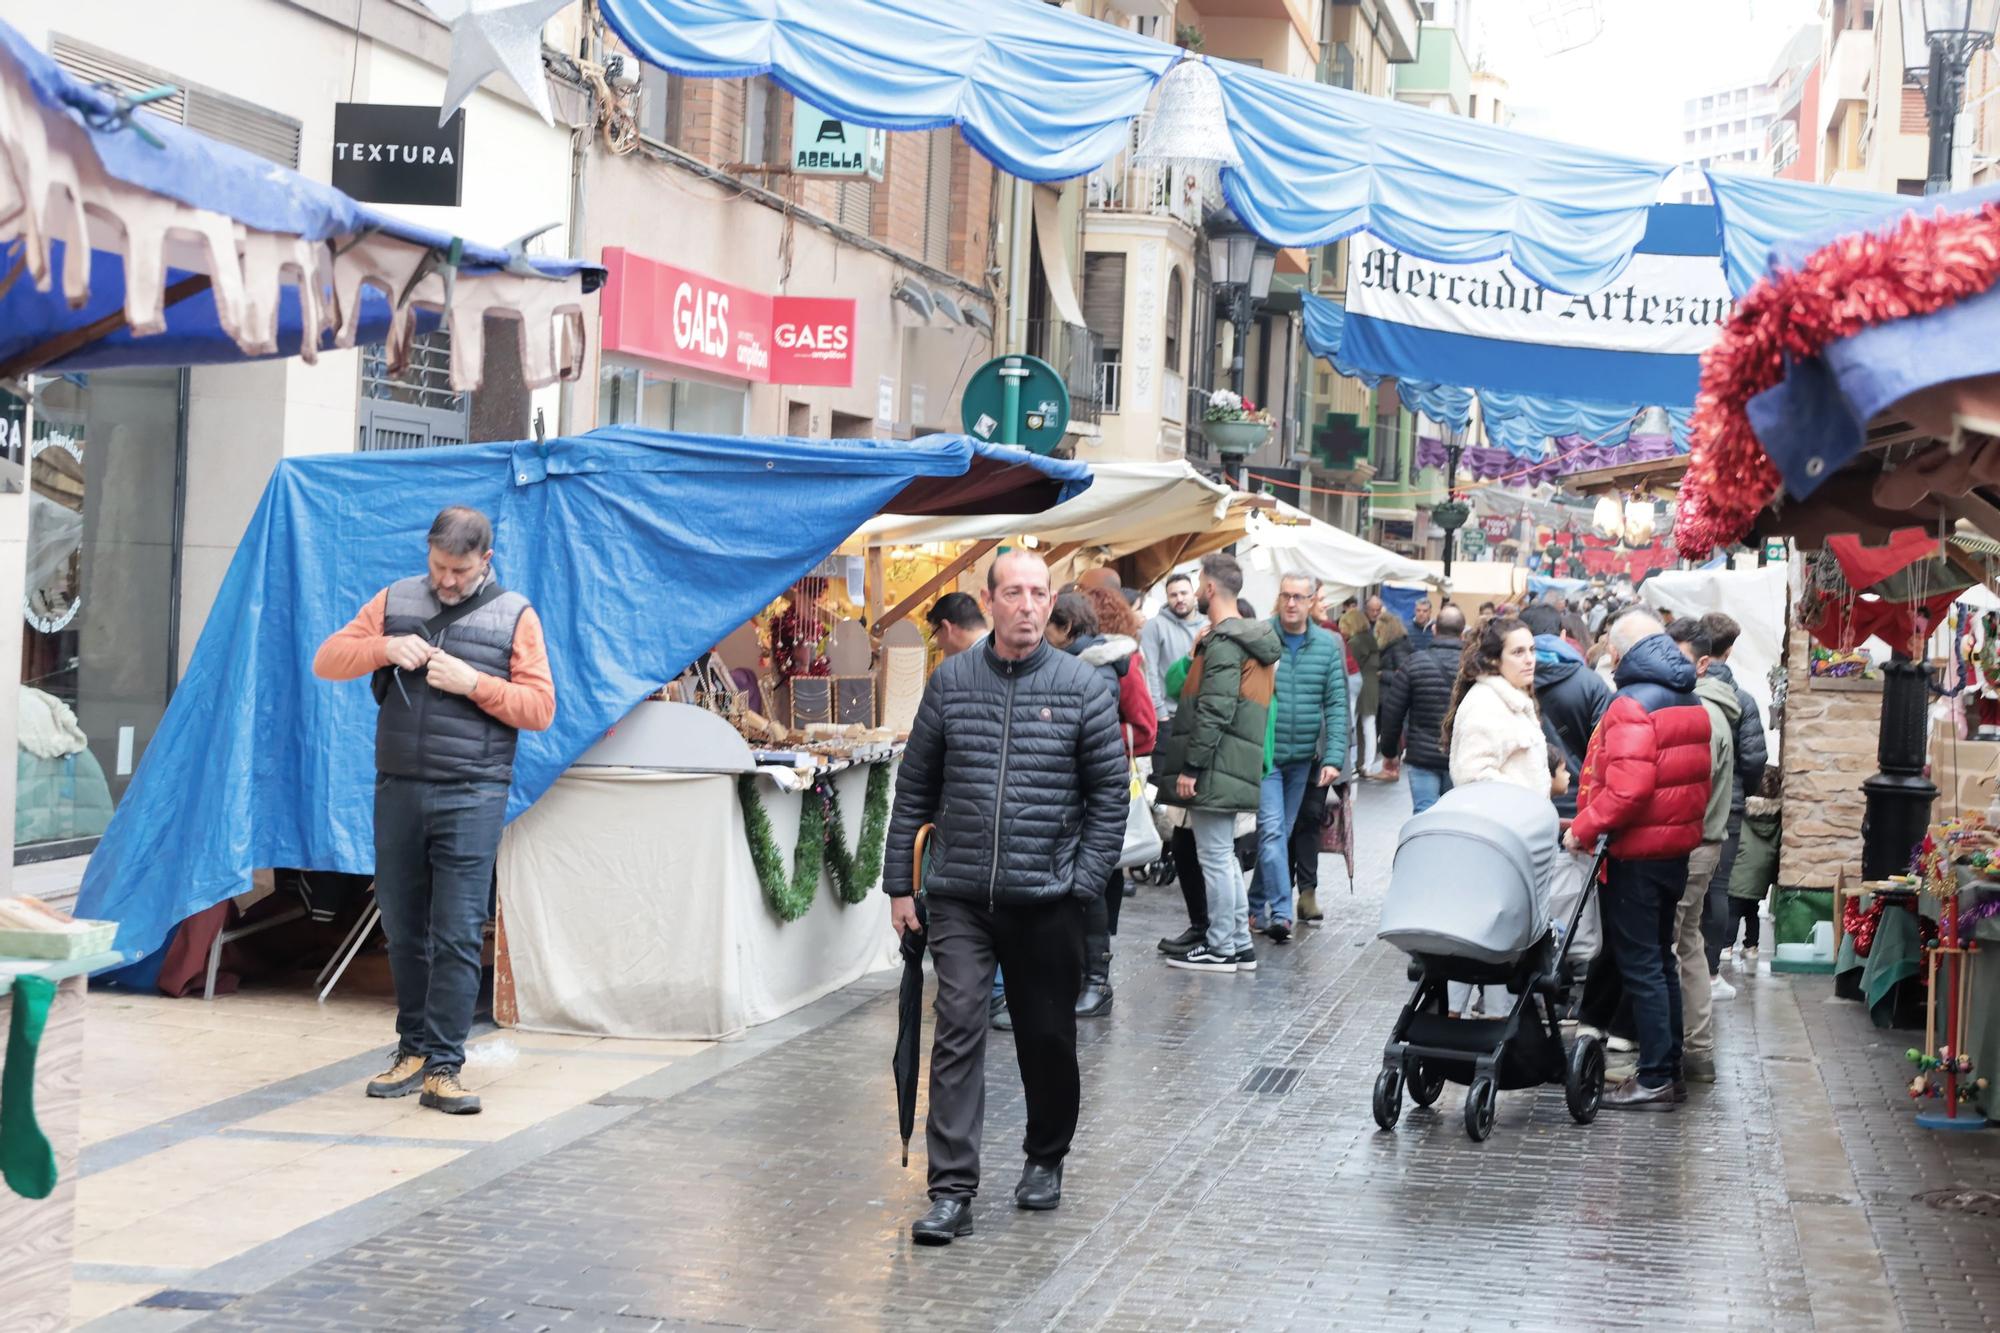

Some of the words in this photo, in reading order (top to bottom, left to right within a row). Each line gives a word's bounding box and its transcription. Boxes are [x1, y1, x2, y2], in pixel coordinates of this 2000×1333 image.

[335, 142, 454, 165] TEXTURA
[797, 151, 863, 169] ABELLA
[1360, 247, 1547, 315] Mercado
[673, 281, 730, 359] GAES
[774, 323, 849, 350] GAES
